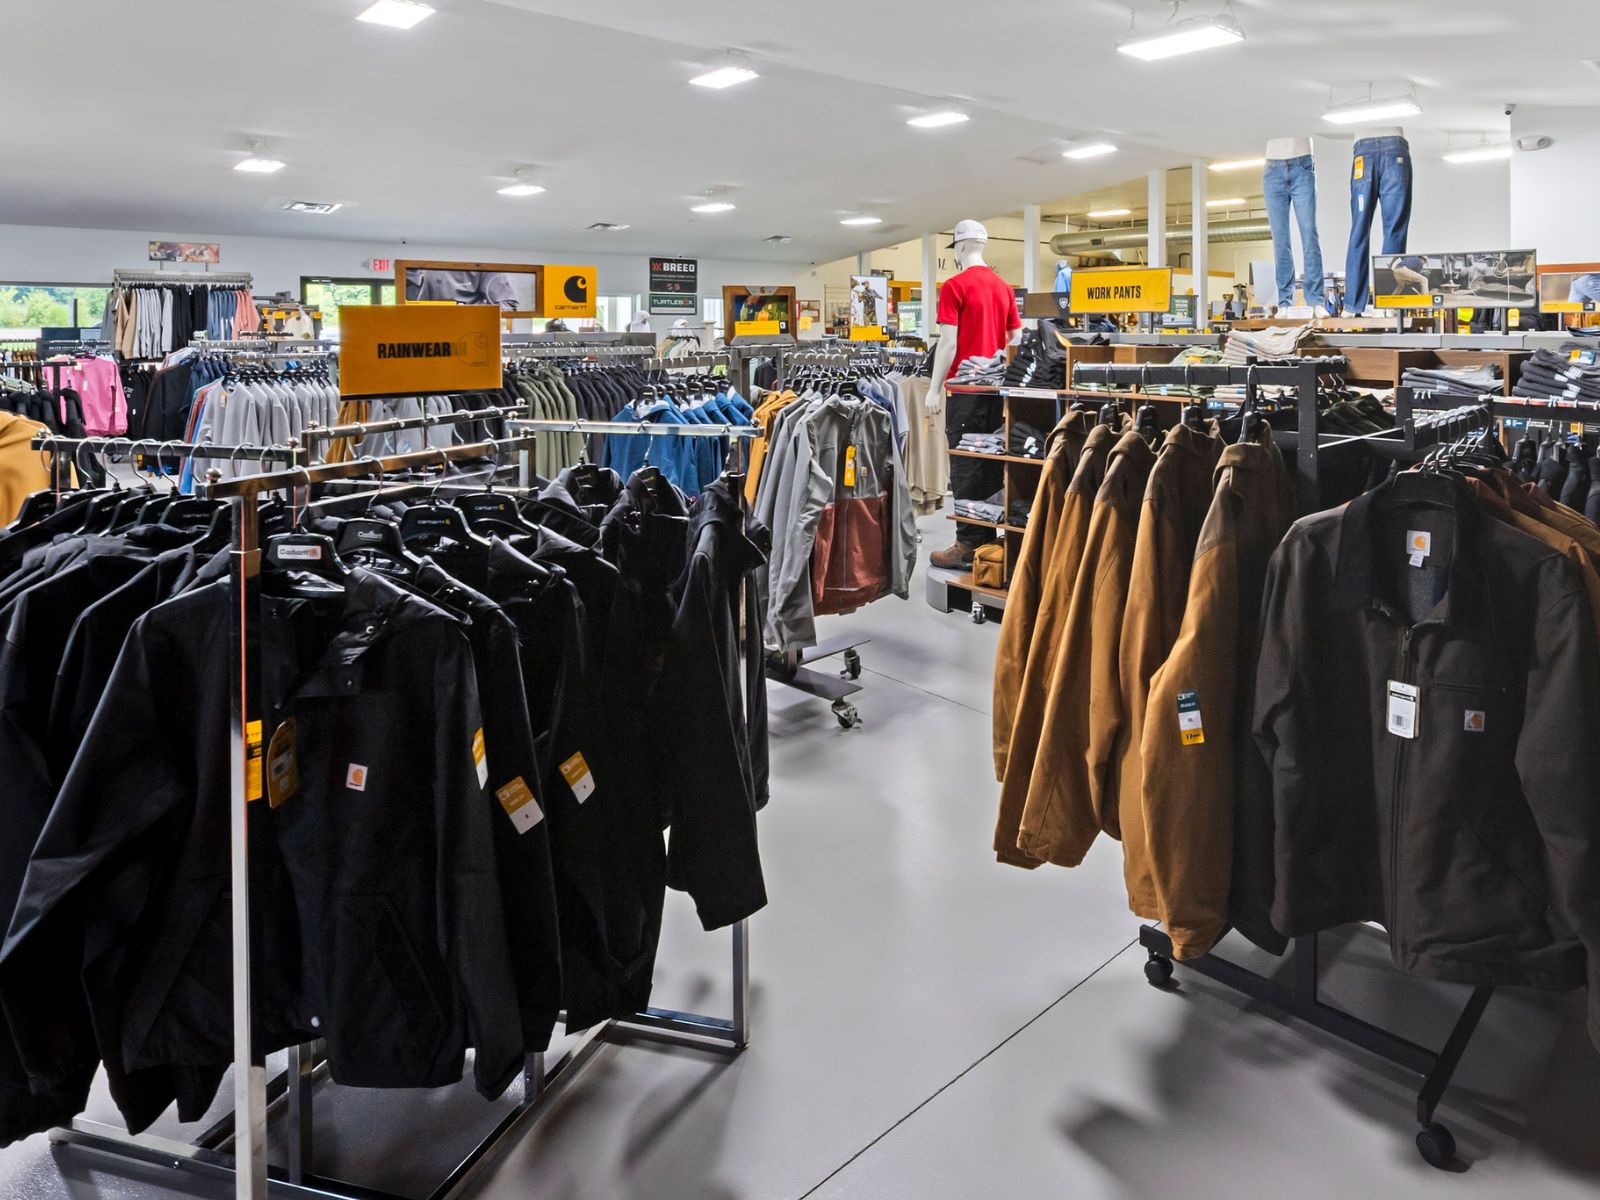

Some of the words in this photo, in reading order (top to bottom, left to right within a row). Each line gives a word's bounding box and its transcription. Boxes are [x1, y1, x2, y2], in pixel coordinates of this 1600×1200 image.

[373, 259, 390, 270] EXIT
[662, 262, 695, 272] BREEO
[1087, 287, 1111, 300] WORK
[1113, 285, 1141, 299] PANTS
[377, 342, 452, 358] RAINWEAR
